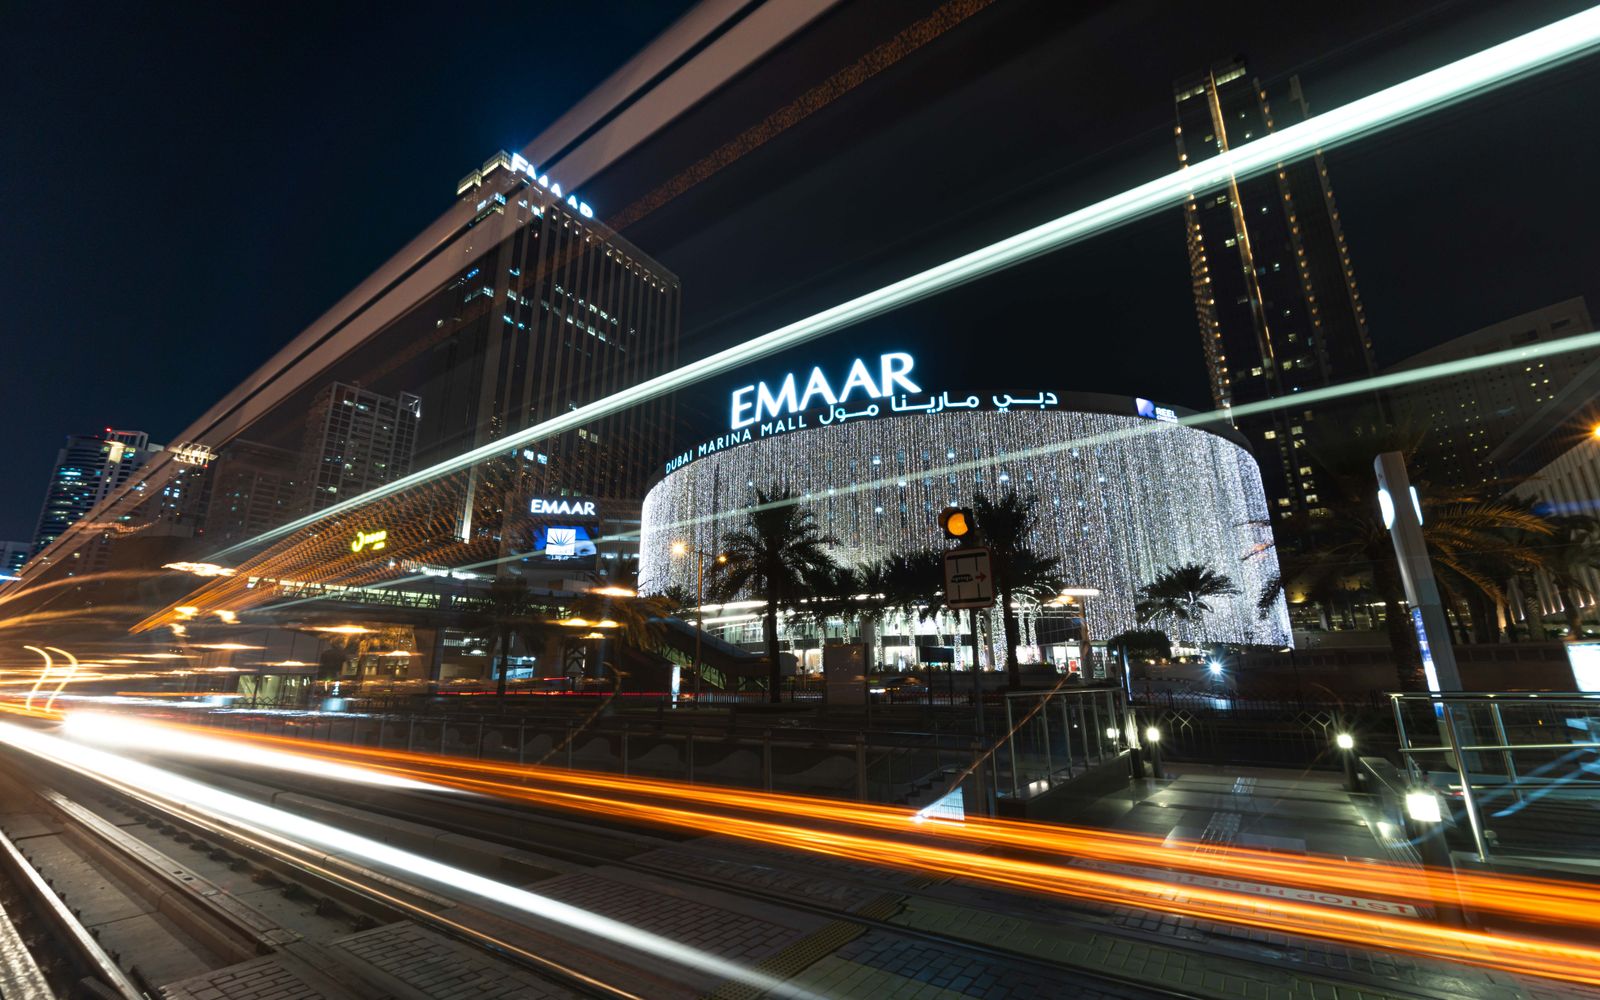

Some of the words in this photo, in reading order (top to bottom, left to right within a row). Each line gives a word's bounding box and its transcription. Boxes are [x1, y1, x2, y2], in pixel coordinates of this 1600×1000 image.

[731, 352, 922, 430] EMAAR
[992, 391, 1058, 412] دبي
[891, 391, 980, 413] مارينا
[818, 404, 879, 425] مول
[665, 450, 693, 474] DUBAI
[698, 428, 752, 457] MARINA
[760, 415, 807, 437] MALL
[530, 498, 596, 516] EMAAR
[1296, 893, 1388, 911] STOP
